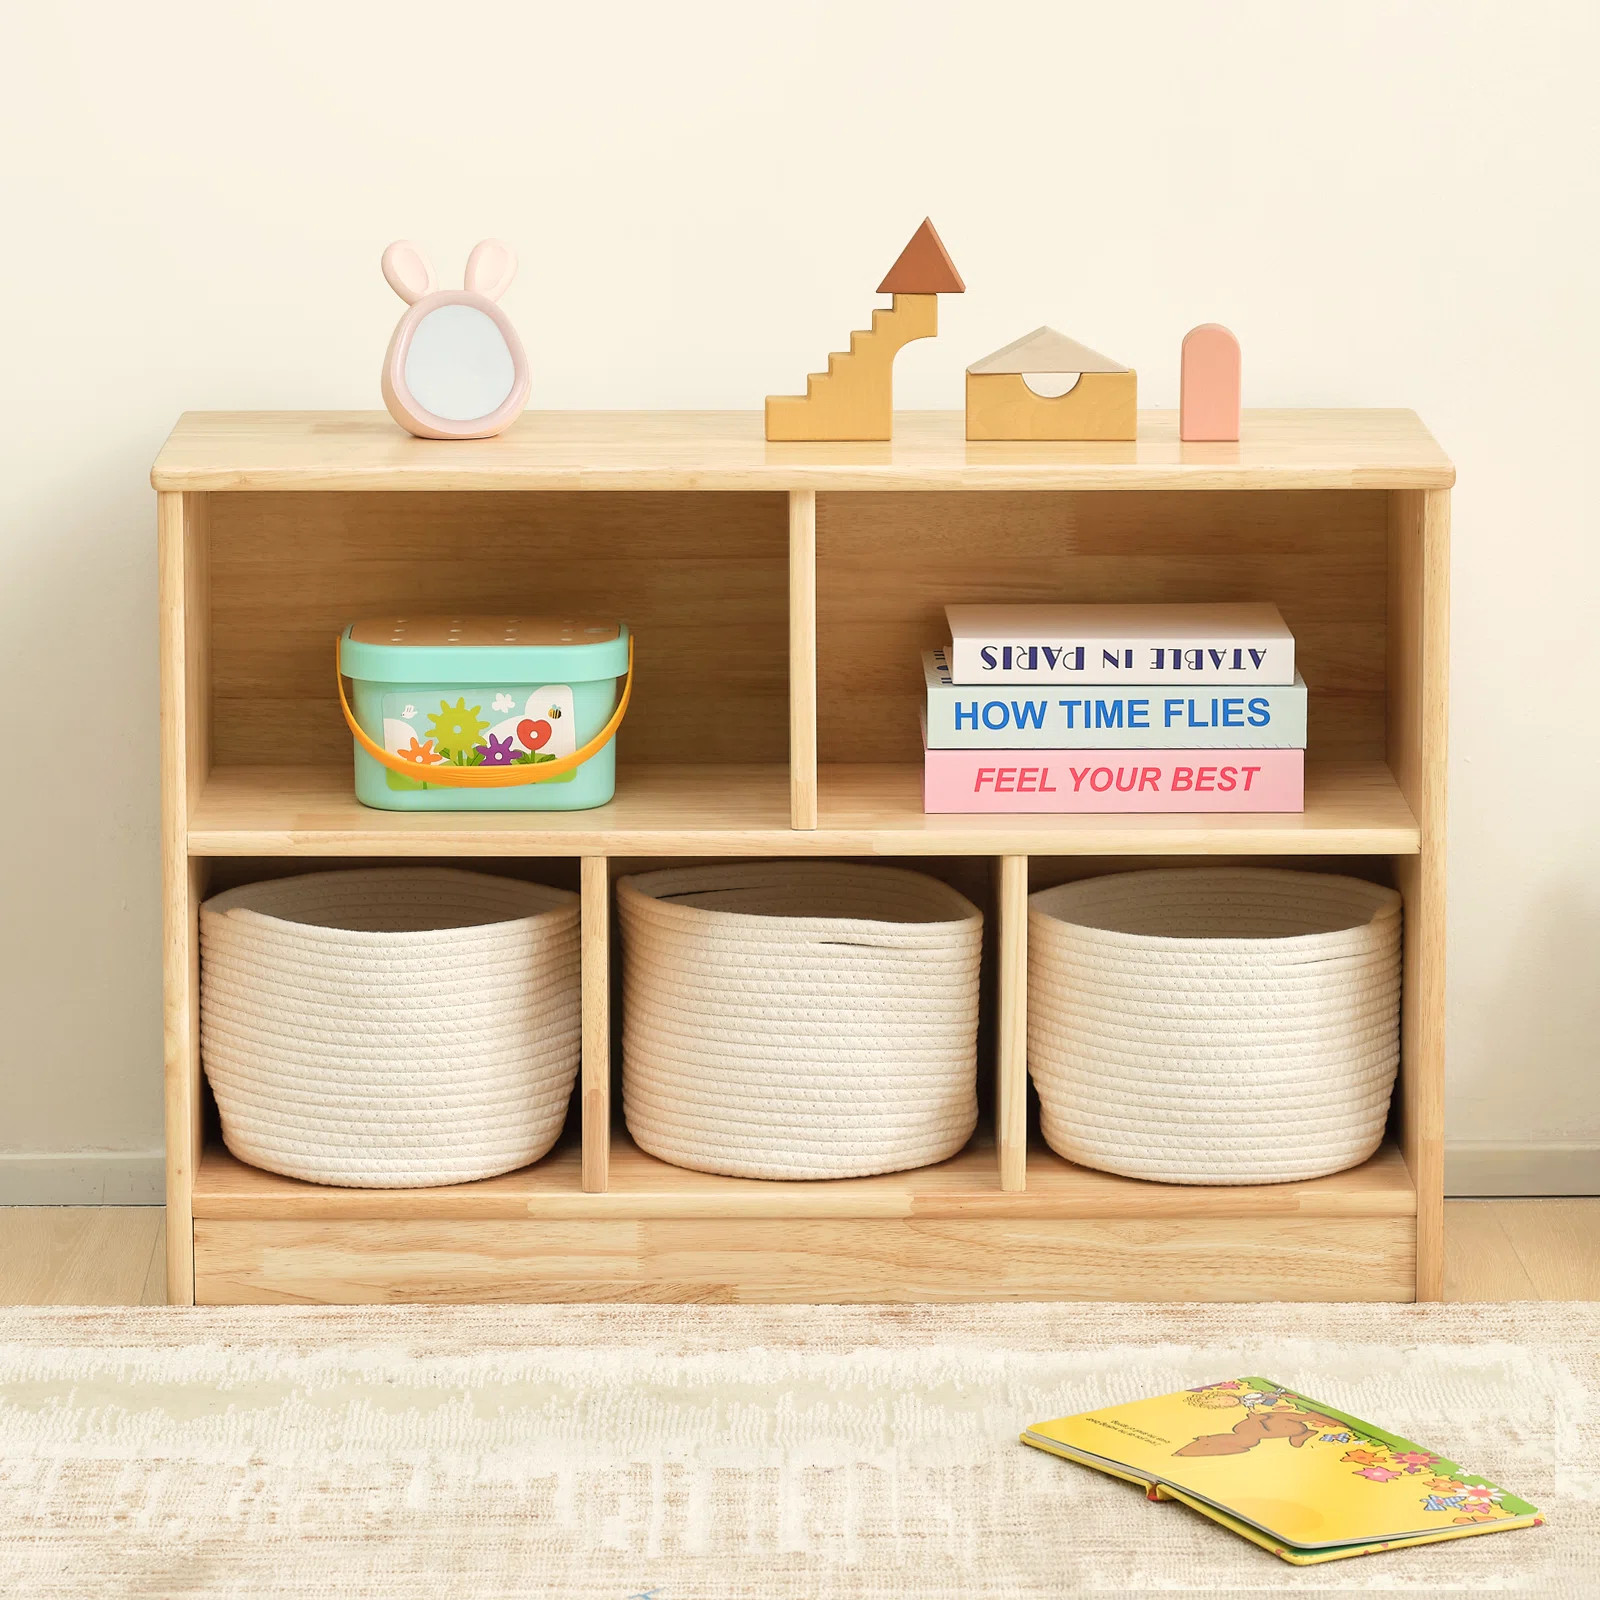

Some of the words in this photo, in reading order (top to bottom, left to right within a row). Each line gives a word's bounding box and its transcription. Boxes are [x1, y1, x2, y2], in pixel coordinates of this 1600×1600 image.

[980, 645, 1085, 671] PARIS
[1102, 648, 1134, 669] IN
[954, 700, 1048, 731] HOW
[1058, 699, 1150, 729] TIME
[1164, 697, 1271, 728] FLIES
[973, 767, 1057, 793] FEEL
[1068, 766, 1162, 793] YOUR
[1170, 766, 1262, 792] BEST
